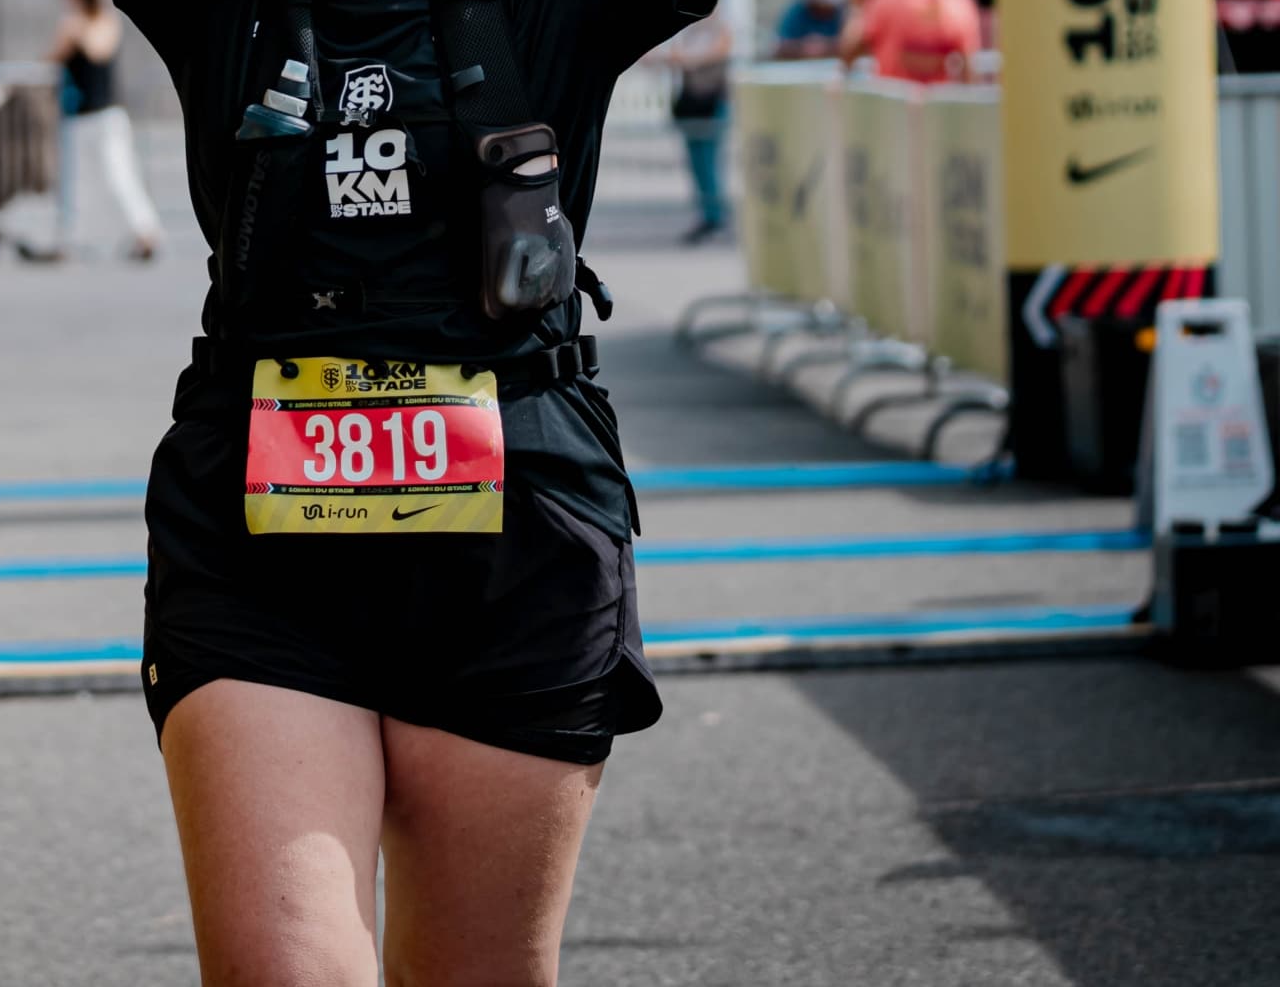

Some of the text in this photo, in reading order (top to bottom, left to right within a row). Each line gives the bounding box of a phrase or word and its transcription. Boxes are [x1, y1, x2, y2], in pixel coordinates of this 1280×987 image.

[325, 128, 407, 173] 10
[325, 169, 410, 205] KM
[343, 201, 412, 217] STADE
[358, 379, 426, 391] STADE
[303, 410, 448, 482] 3819
[328, 504, 367, 519] i-run
